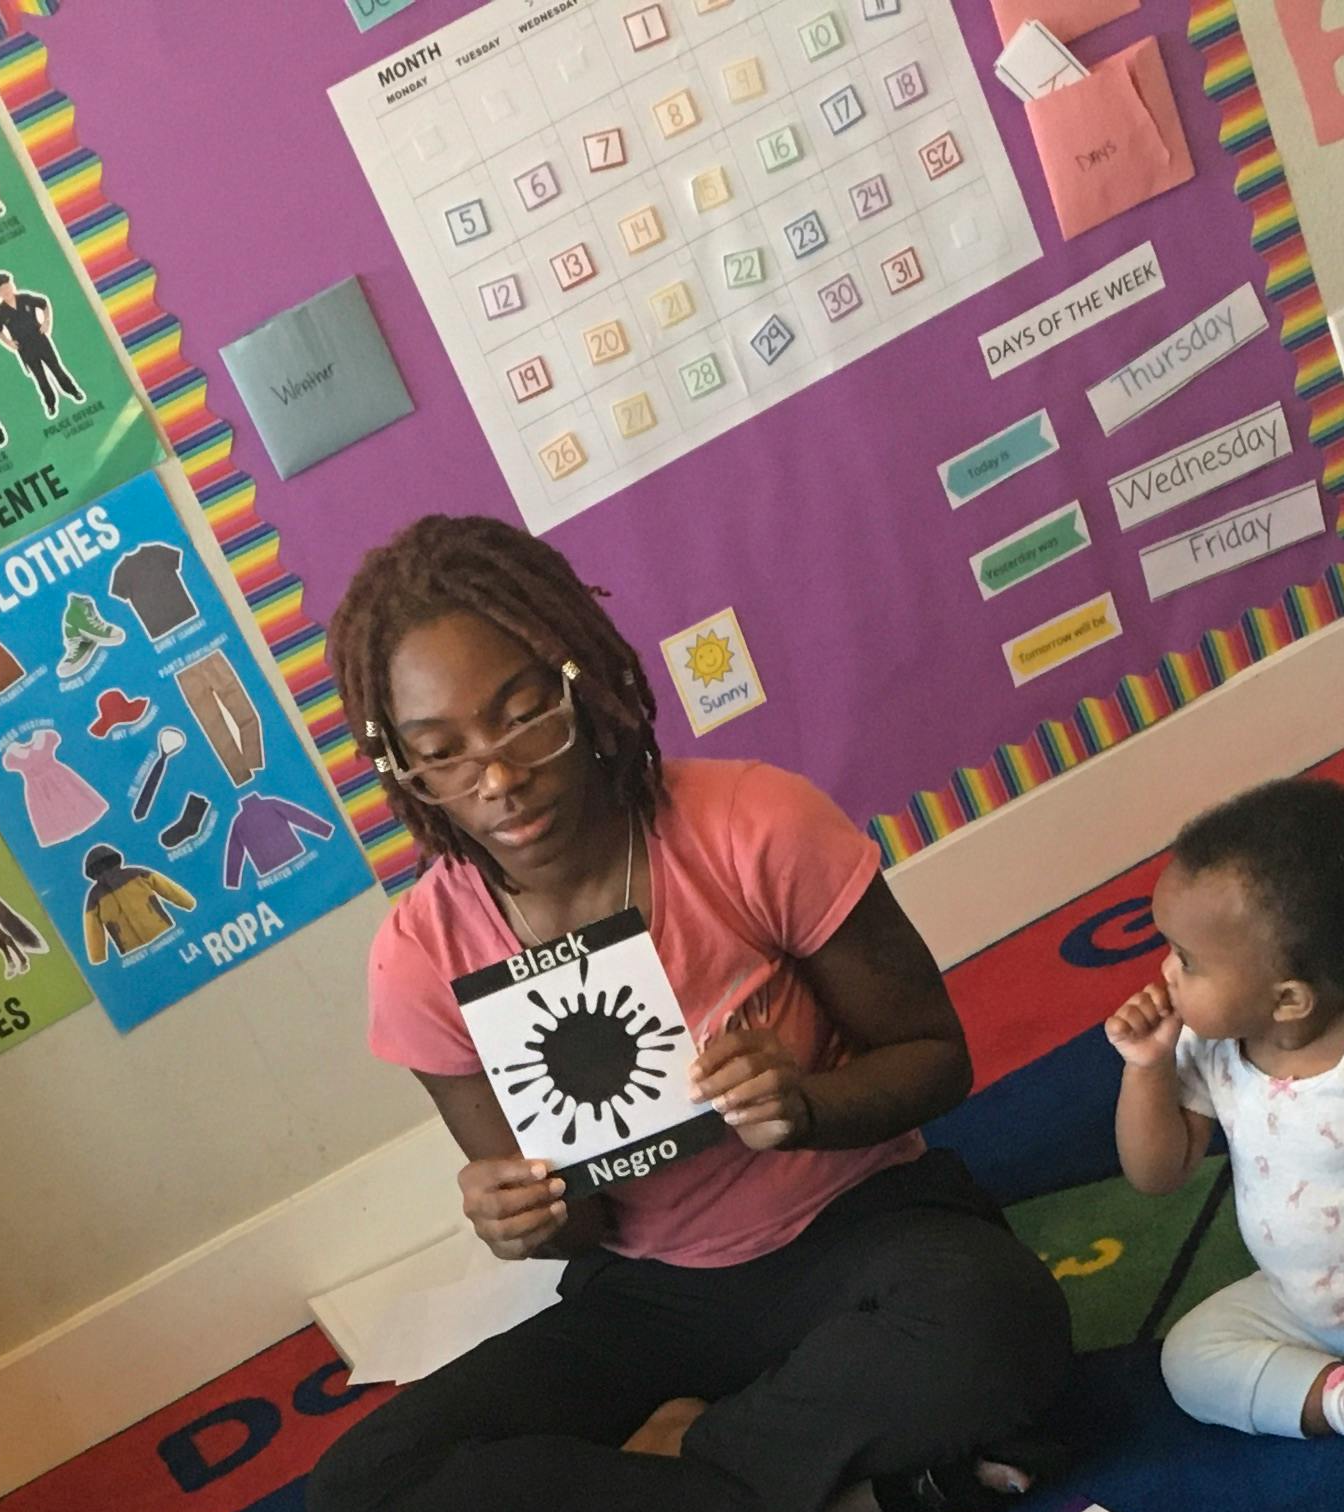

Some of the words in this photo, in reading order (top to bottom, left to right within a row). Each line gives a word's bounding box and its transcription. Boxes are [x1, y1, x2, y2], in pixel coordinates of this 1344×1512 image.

[641, 15, 652, 39] 1
[808, 23, 833, 52] 10
[377, 42, 443, 88] MONTH
[456, 36, 502, 67] TUESDAY
[386, 76, 429, 105] MONDAY
[897, 71, 918, 100] 18
[667, 102, 684, 127] 8
[832, 93, 853, 125] 17
[596, 136, 613, 163] 7
[769, 133, 792, 160] 16
[925, 145, 954, 175] 25
[529, 173, 548, 198] 6
[856, 182, 884, 215] 24
[459, 208, 477, 236] 5
[630, 217, 653, 246] 14
[792, 220, 821, 251] 23
[560, 253, 584, 281] 13
[729, 254, 757, 281] 22
[891, 257, 913, 284] 31
[492, 283, 514, 311] 12
[824, 283, 853, 314] 30
[986, 331, 1037, 366] DAYS
[1037, 310, 1064, 338] OF
[1064, 289, 1105, 322] THE
[1104, 260, 1158, 299] WEEK
[591, 330, 620, 358] 20
[759, 323, 785, 357] 29
[1110, 305, 1238, 398] Thursday
[519, 364, 539, 388] 19
[687, 362, 716, 392] 28
[621, 401, 647, 429] 27
[547, 442, 578, 473] 26
[967, 457, 1000, 480] Today
[1115, 419, 1280, 510] Wednesday
[1188, 512, 1275, 564] Friday
[699, 682, 749, 714] Sunny
[179, 941, 202, 965] LA
[201, 900, 285, 967] ROPA
[506, 931, 590, 983] Black
[587, 1138, 679, 1187] Negro
